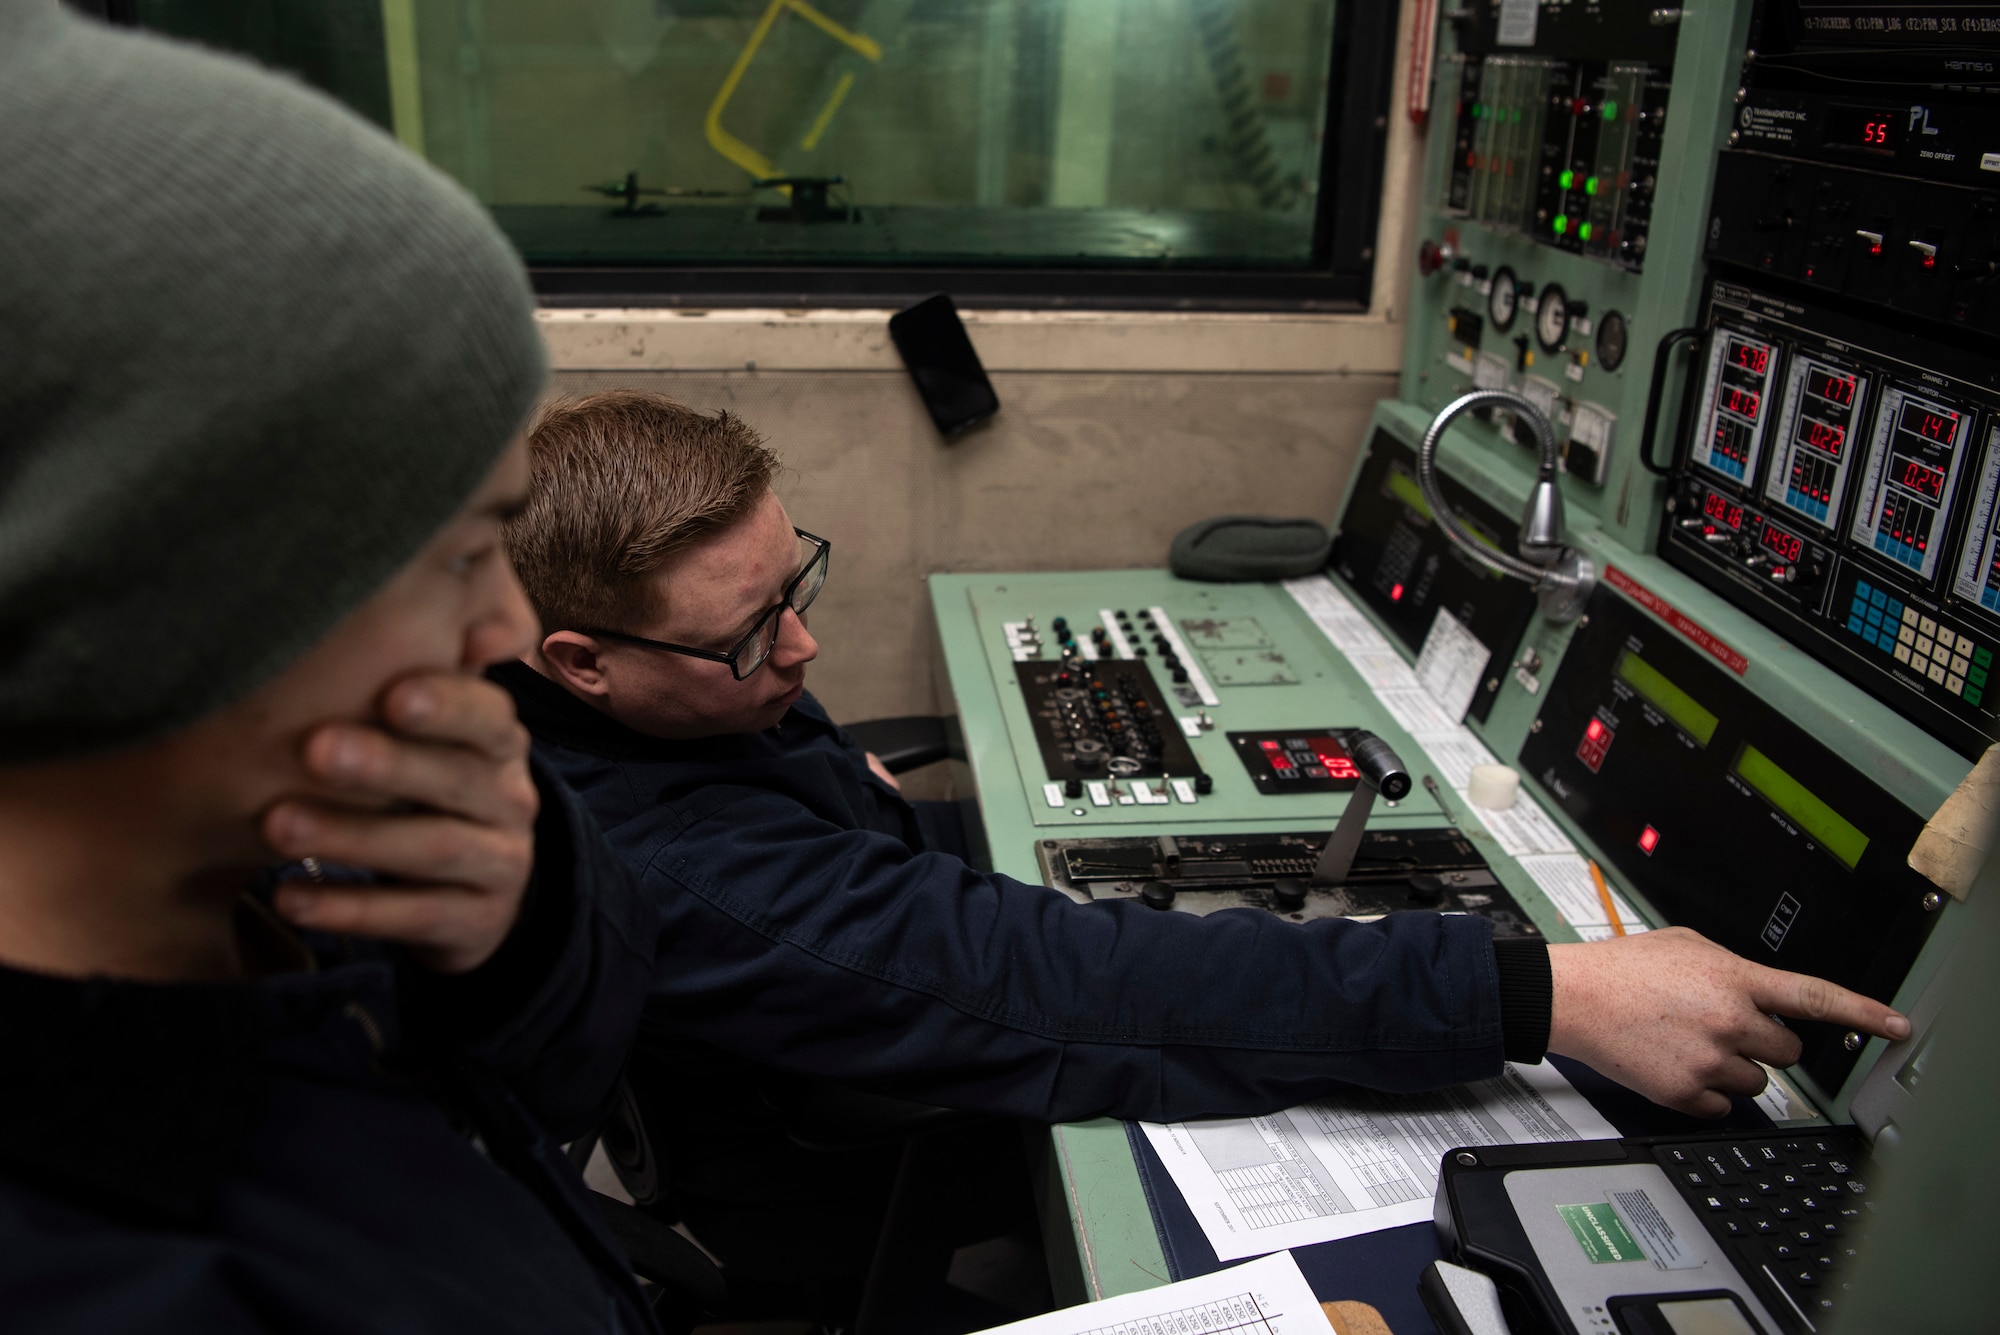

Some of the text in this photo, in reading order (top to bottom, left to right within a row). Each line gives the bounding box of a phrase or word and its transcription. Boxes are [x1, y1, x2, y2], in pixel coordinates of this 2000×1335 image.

[1855, 17, 1902, 32] <F1>PRN_LOG
[1905, 17, 1957, 33] <F2>PRN_SCR
[1908, 104, 1940, 136] PL
[1864, 122, 1888, 144] 55
[1919, 150, 1956, 162] ZERO OFFSET
[1921, 372, 1945, 386] CHANNEL
[1917, 385, 1939, 399] MONITOR
[1903, 462, 1943, 498] 0.24
[1909, 592, 1940, 612] PROGRAMMER
[1892, 669, 1926, 694] PROGRAMMER
[1741, 785, 1752, 797] TEMP
[1786, 823, 1798, 836] TEMP
[1529, 1089, 1553, 1114] BALANCE
[1270, 1144, 1283, 1162] GRAMS
[1731, 1146, 1752, 1168] Caps Lock
[1276, 1164, 1287, 1179] FINAL
[1295, 1189, 1313, 1213] LOCATION
[1280, 1180, 1297, 1200] LOOKING
[1213, 1200, 1231, 1225] SEPTEMBER
[1581, 1205, 1623, 1261] UNCLASSIFIED
[1210, 1308, 1224, 1326] 4750
[1221, 1305, 1235, 1323] 4500
[1233, 1302, 1247, 1320] 4250
[1245, 1299, 1258, 1318] 4000
[1164, 1319, 1178, 1335] 5750
[1175, 1317, 1189, 1334] 5500
[1187, 1314, 1201, 1331] 5250
[1198, 1311, 1213, 1329] 5000
